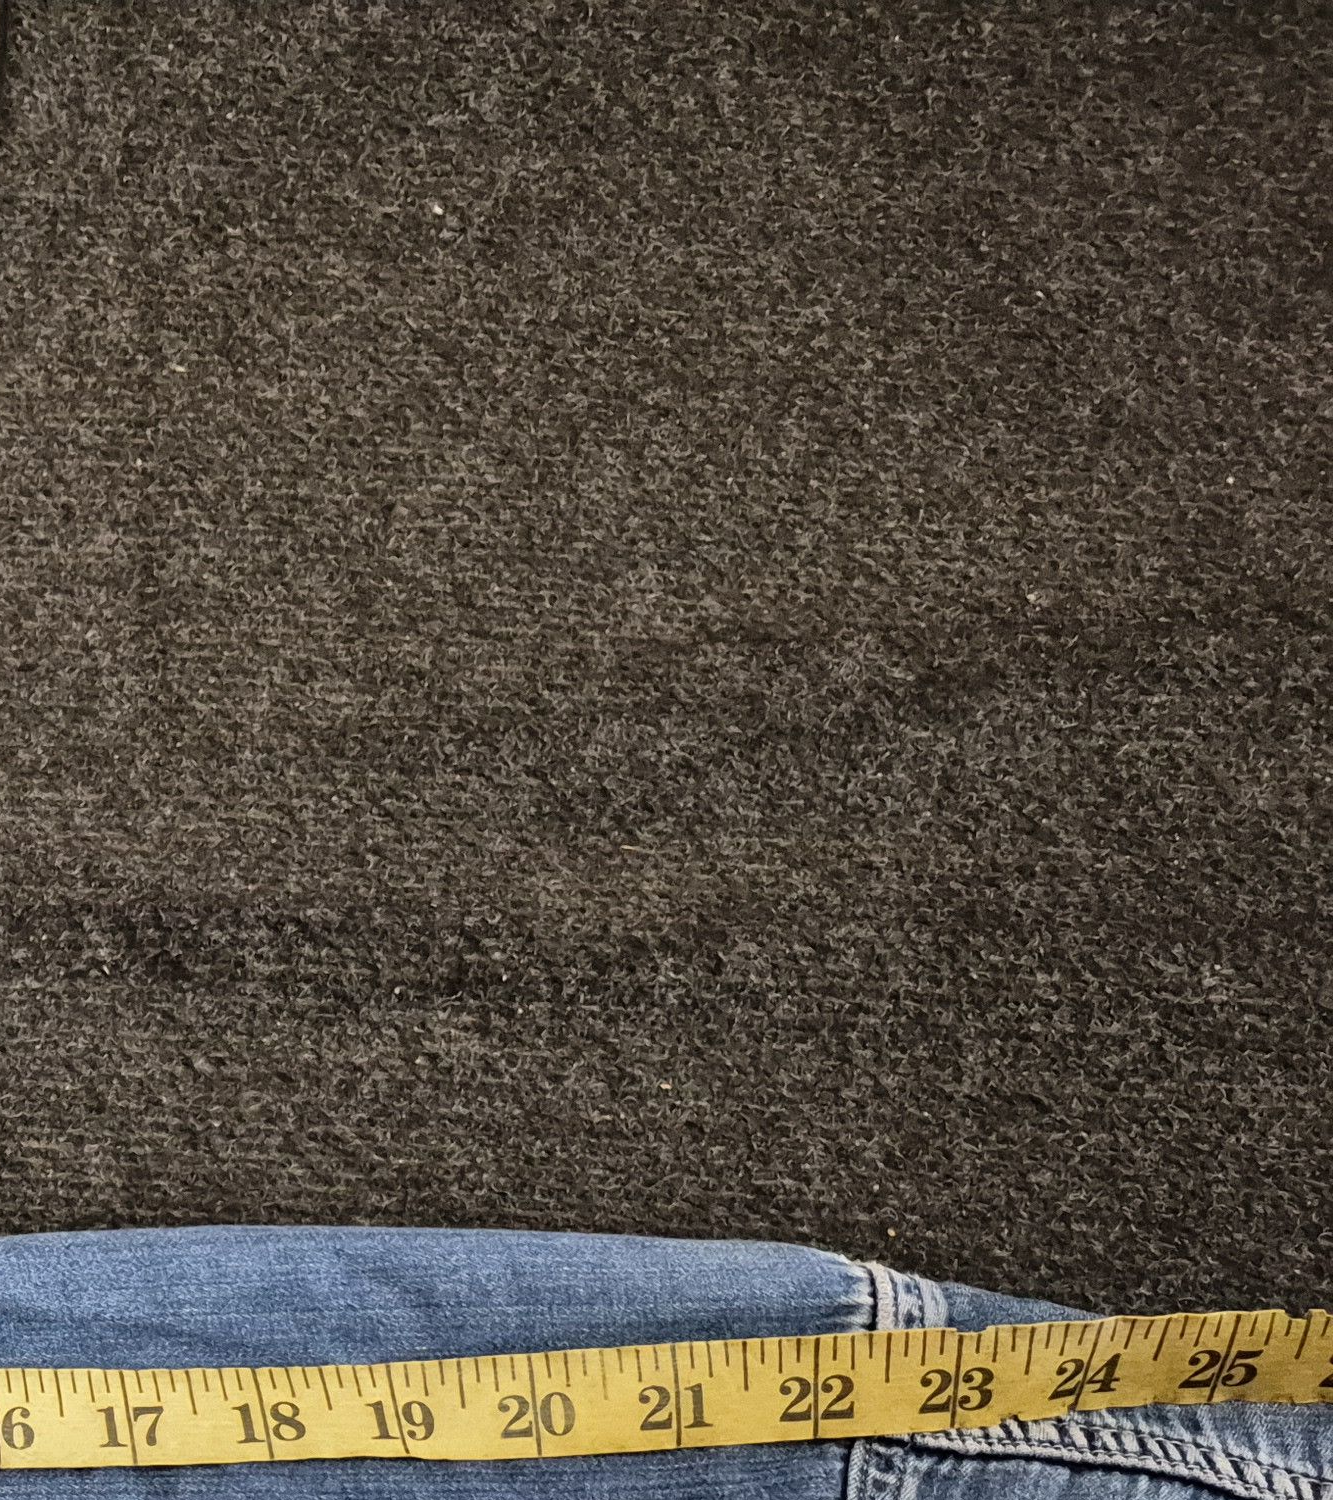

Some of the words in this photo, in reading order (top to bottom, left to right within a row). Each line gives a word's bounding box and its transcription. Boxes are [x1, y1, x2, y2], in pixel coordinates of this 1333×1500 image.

[99, 1405, 163, 1448] 17
[232, 1401, 306, 1443] 18
[366, 1400, 435, 1441] 19
[497, 1391, 576, 1438] 20
[638, 1382, 714, 1431] 21
[779, 1374, 855, 1423] 22
[919, 1366, 994, 1414] 23
[1048, 1353, 1122, 1400] 24
[1178, 1348, 1265, 1389] 25
